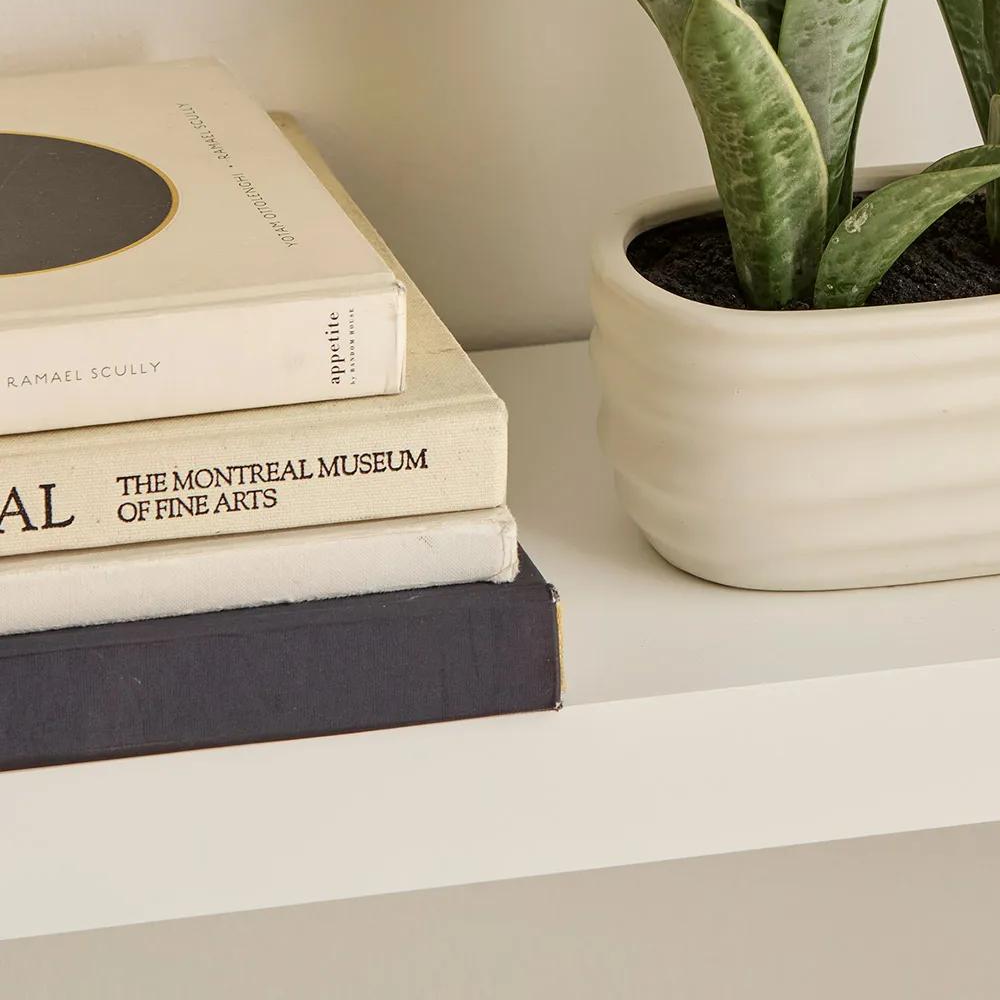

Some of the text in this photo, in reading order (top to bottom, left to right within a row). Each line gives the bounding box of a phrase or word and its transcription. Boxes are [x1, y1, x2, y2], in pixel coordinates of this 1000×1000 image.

[176, 102, 298, 248] YOTAM OTTOLENGHI RAMAEL SCULLY
[325, 312, 345, 385] appetite
[7, 361, 160, 388] RAMAEL SCULLY
[116, 448, 428, 495] THE MONTREAL MUSEUM
[117, 488, 278, 523] OF FINE ARTS
